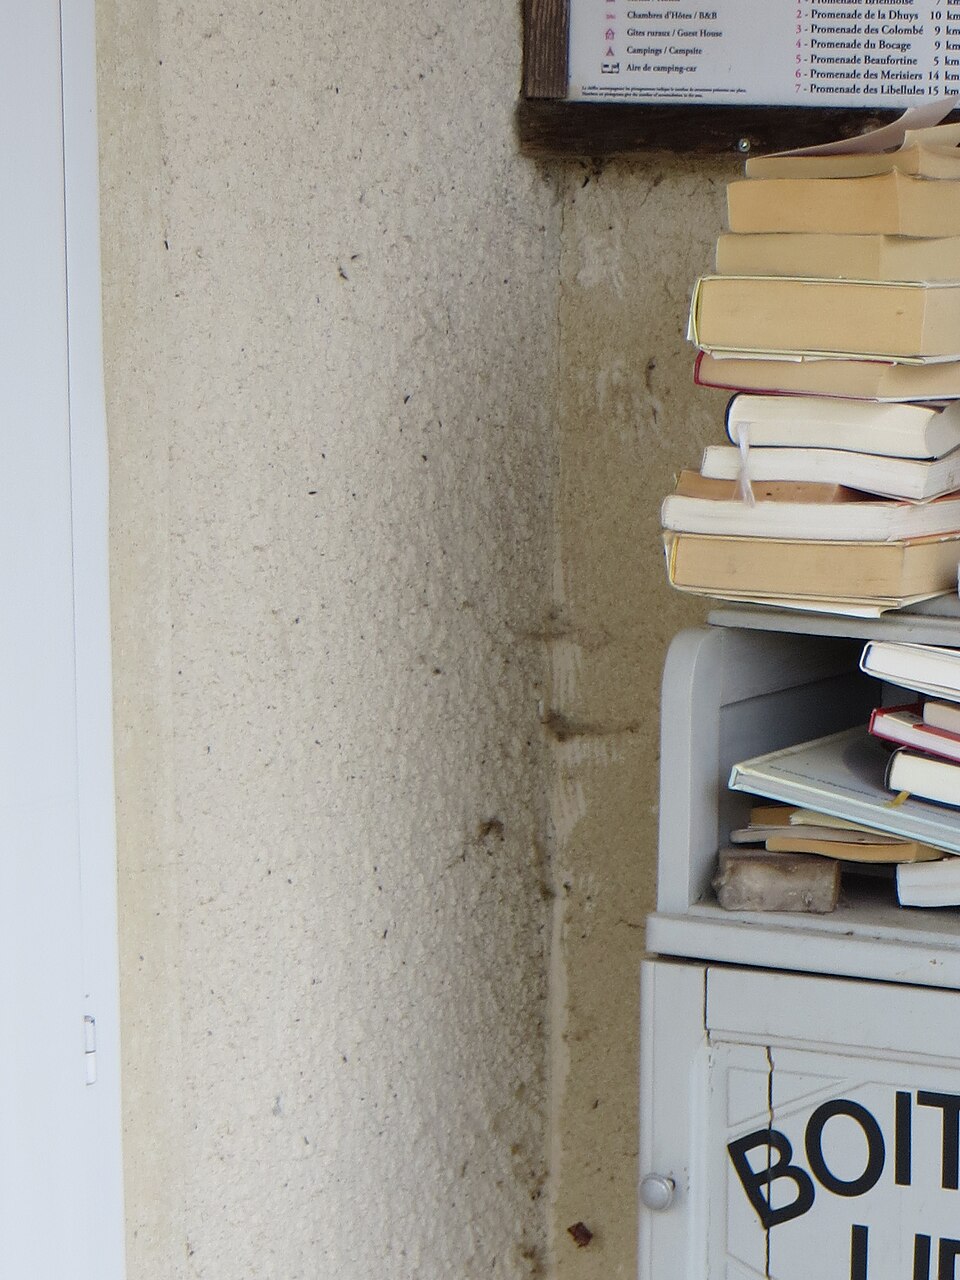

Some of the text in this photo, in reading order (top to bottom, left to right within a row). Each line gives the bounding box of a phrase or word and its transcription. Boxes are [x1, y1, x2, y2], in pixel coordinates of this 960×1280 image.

[627, 11, 662, 19] Chambres
[796, 9, 802, 19] 2
[812, 9, 862, 19] Promenade
[865, 10, 875, 19] de
[878, 10, 885, 19] la
[889, 11, 918, 22] Dhuys
[931, 11, 941, 19] 10
[947, 11, 960, 20] km
[700, 29, 722, 37] House
[796, 25, 802, 34] 3
[811, 24, 861, 34] Promenade
[864, 25, 878, 34] des
[882, 25, 923, 35] Colombé
[935, 26, 940, 35] 9
[946, 26, 960, 35] km
[627, 46, 662, 56] Campings
[795, 39, 802, 49] 4
[811, 39, 861, 48] Promenade
[864, 40, 875, 48] du
[879, 40, 911, 52] Bocage
[935, 41, 940, 50] 9
[946, 41, 960, 50] km
[795, 54, 801, 65] 5
[811, 54, 861, 64] Promenade
[865, 55, 917, 65] Beaufortine
[933, 56, 940, 66] 5
[945, 56, 959, 66] km
[653, 65, 696, 74] camping-car
[795, 69, 801, 79] 6
[811, 69, 861, 79] Promenade
[864, 70, 878, 79] des
[881, 70, 922, 80] Merisiers
[930, 71, 939, 80] 14
[945, 71, 959, 80] km
[795, 84, 801, 93] 7
[811, 84, 860, 93] Promenade
[863, 85, 877, 93] des
[881, 85, 924, 94] Libellules
[929, 86, 938, 95] 15
[945, 86, 959, 95] km
